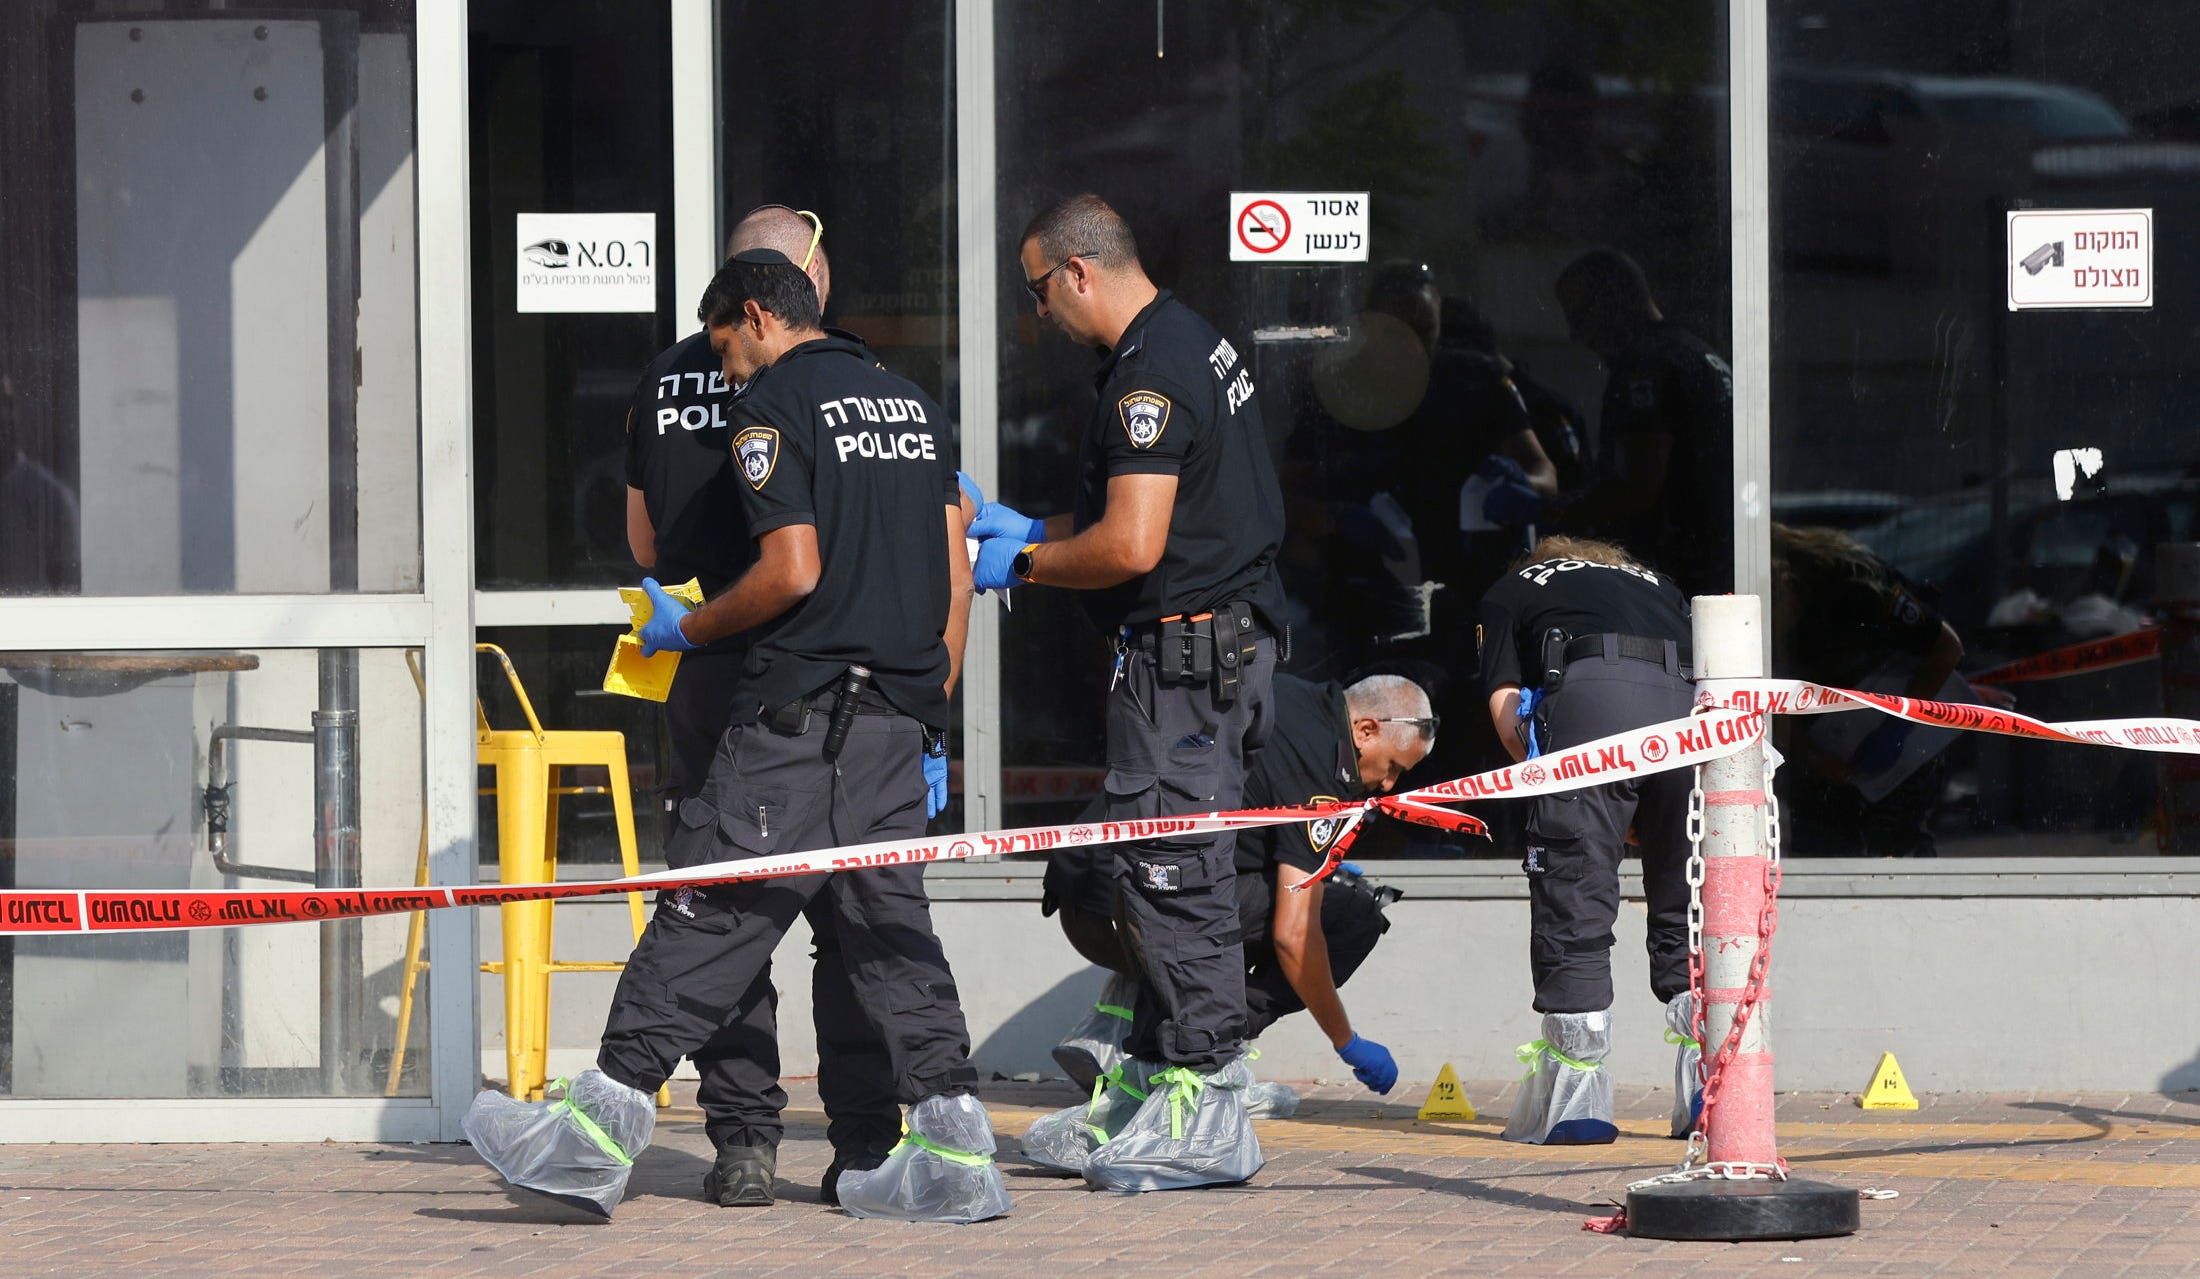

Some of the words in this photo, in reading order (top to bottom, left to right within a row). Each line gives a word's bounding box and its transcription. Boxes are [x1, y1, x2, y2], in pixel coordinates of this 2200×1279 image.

[1306, 200, 1359, 216] אסור
[1305, 231, 1361, 254] לעשן
[2074, 230, 2139, 253] המקום
[578, 240, 650, 267] ר.ס.א
[522, 273, 549, 286] בע"מ
[551, 274, 591, 285] מרכזיות
[593, 274, 625, 285] תחנות
[626, 272, 651, 286] ניהול
[2073, 265, 2139, 288] מצולם
[1208, 337, 1239, 380] שטרה
[657, 370, 742, 400] טרה
[657, 403, 727, 435] POL
[820, 397, 927, 428] משטרה
[835, 431, 936, 463] POLICE
[1553, 744, 1638, 781] ישראל
[1675, 719, 1712, 755] אין
[1716, 712, 1764, 745] מעב
[981, 830, 1061, 854] ישראל
[8, 900, 73, 923] מעבר
[92, 899, 180, 923] משטרת
[219, 899, 299, 921] ישראל
[335, 893, 369, 914] אין
[1437, 1081, 1455, 1101] 12
